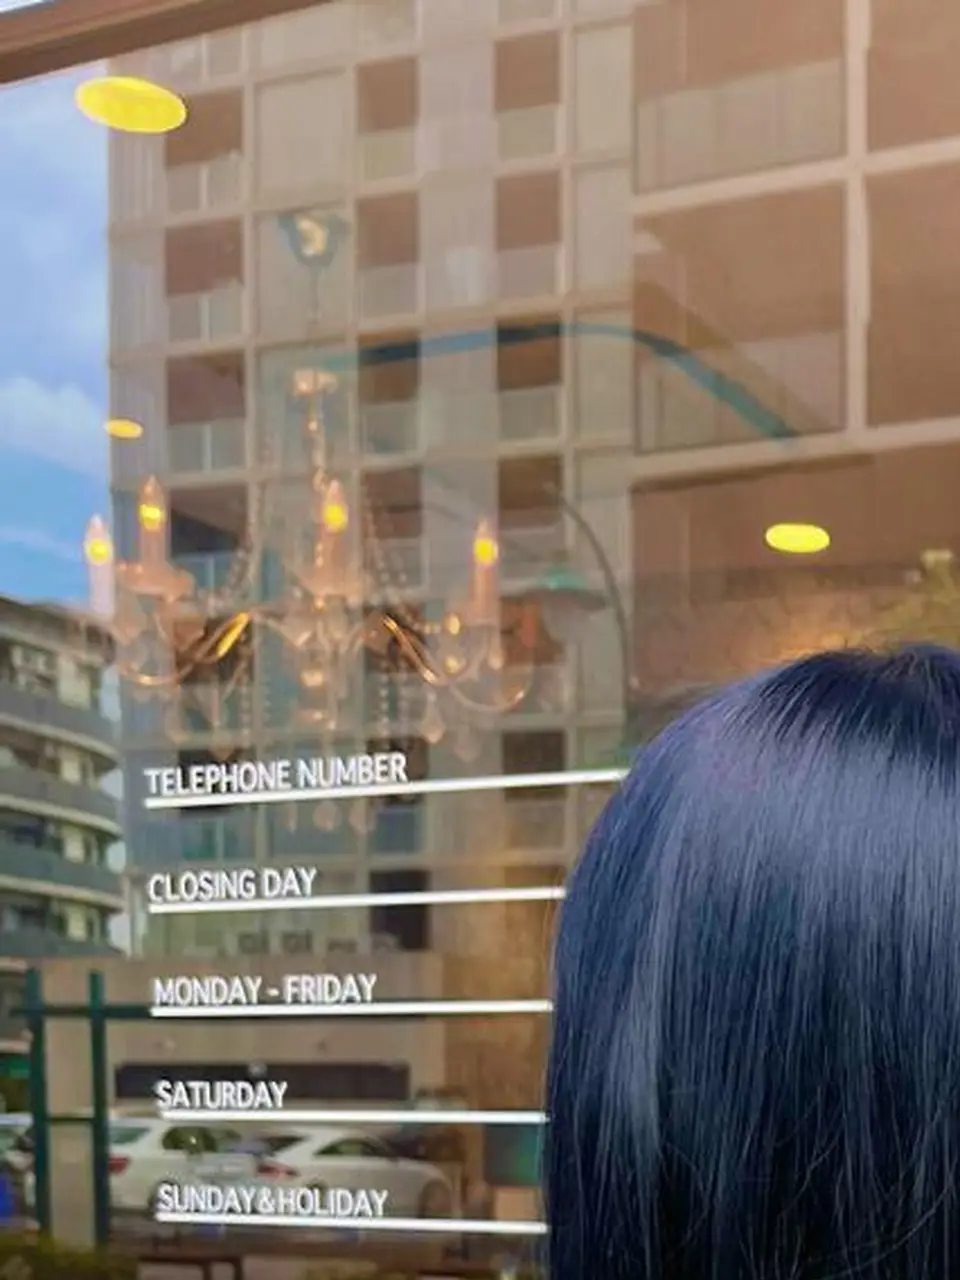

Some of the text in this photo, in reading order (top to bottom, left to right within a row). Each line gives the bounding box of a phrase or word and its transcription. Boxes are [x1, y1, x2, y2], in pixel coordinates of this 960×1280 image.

[145, 753, 407, 795] TELEPHONE NUMBER
[148, 867, 317, 903] CLOSING DAY
[153, 977, 262, 1006] MONDAY
[285, 974, 377, 1004] FRIDAY
[155, 1080, 288, 1110] SATURDAY
[157, 1184, 388, 1217] SUNDAY&HOLIDAY
